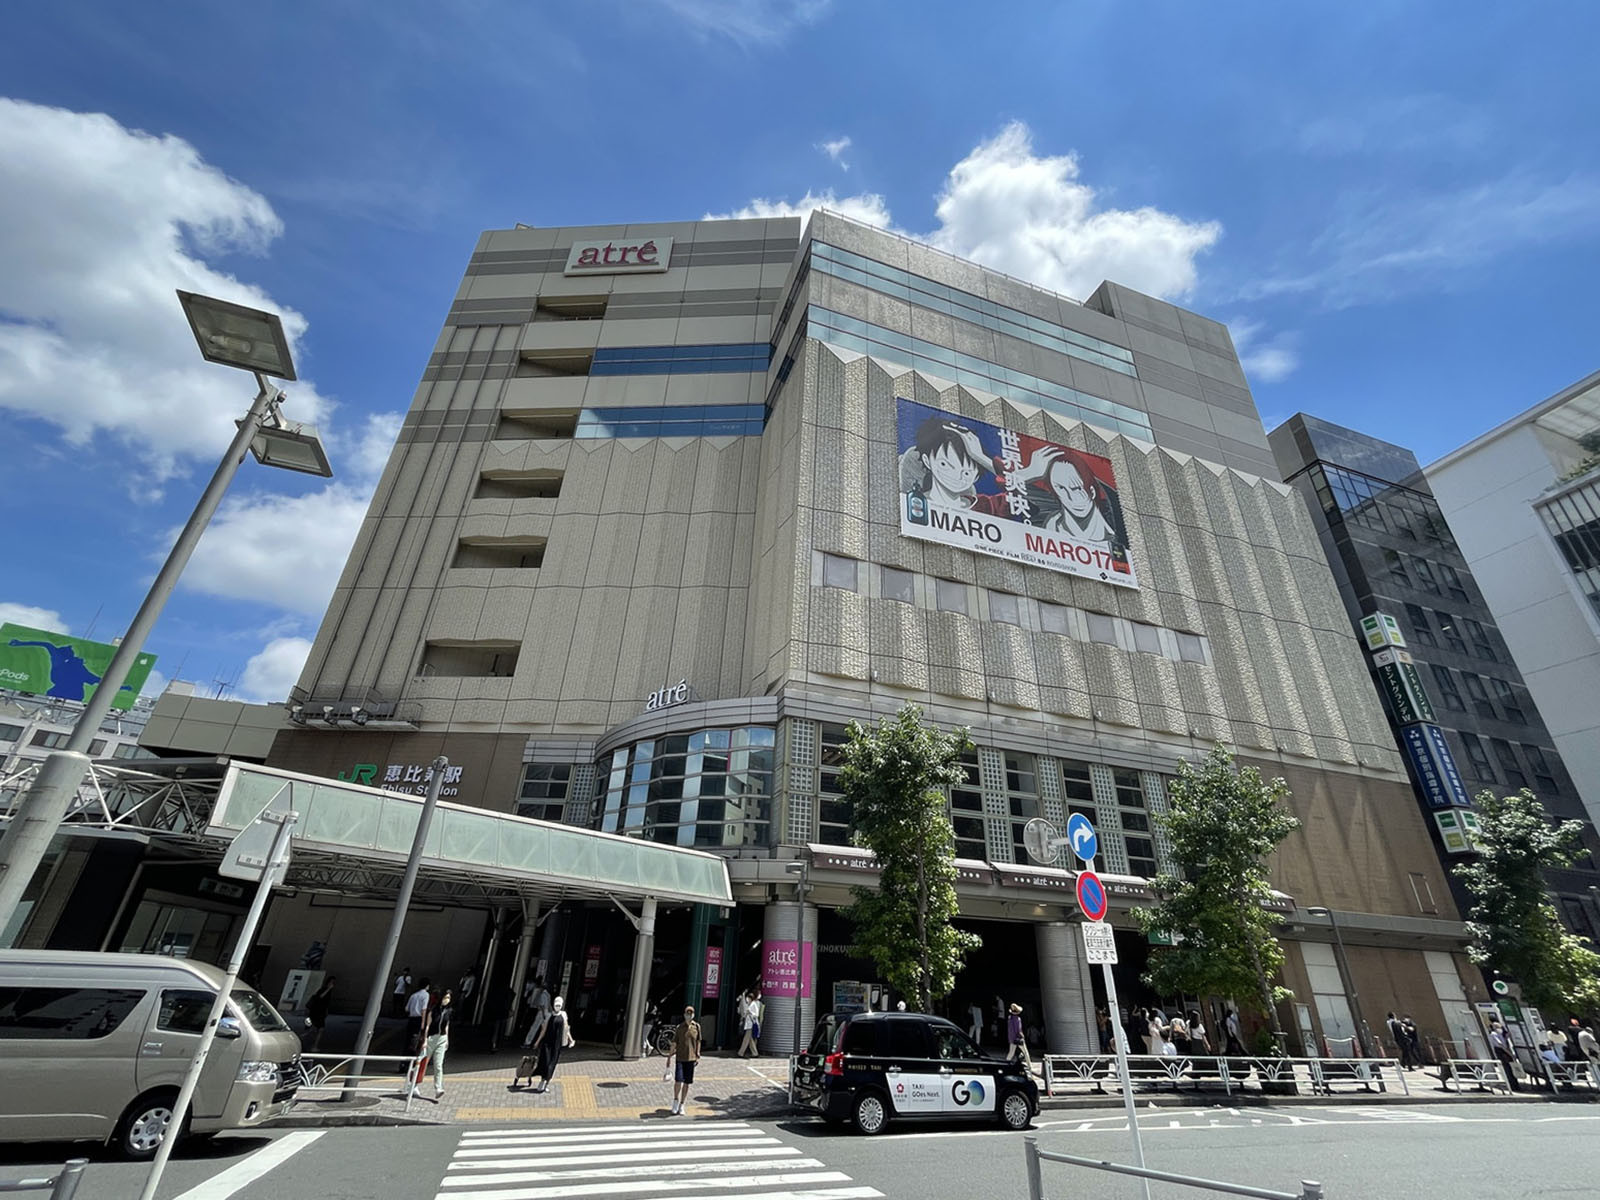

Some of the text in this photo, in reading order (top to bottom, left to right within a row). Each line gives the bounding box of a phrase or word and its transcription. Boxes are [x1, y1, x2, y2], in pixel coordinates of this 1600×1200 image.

[577, 240, 659, 265] atré
[930, 508, 1003, 543] MARO
[1006, 550, 1020, 559] FILM
[1024, 532, 1112, 570] MARO17
[646, 678, 688, 710] atré
[337, 763, 378, 786] JR
[415, 784, 459, 797] Stion
[850, 859, 868, 869] atré
[768, 948, 796, 964] atré
[1088, 950, 1116, 961] ここまで
[951, 1079, 986, 1106] GO
